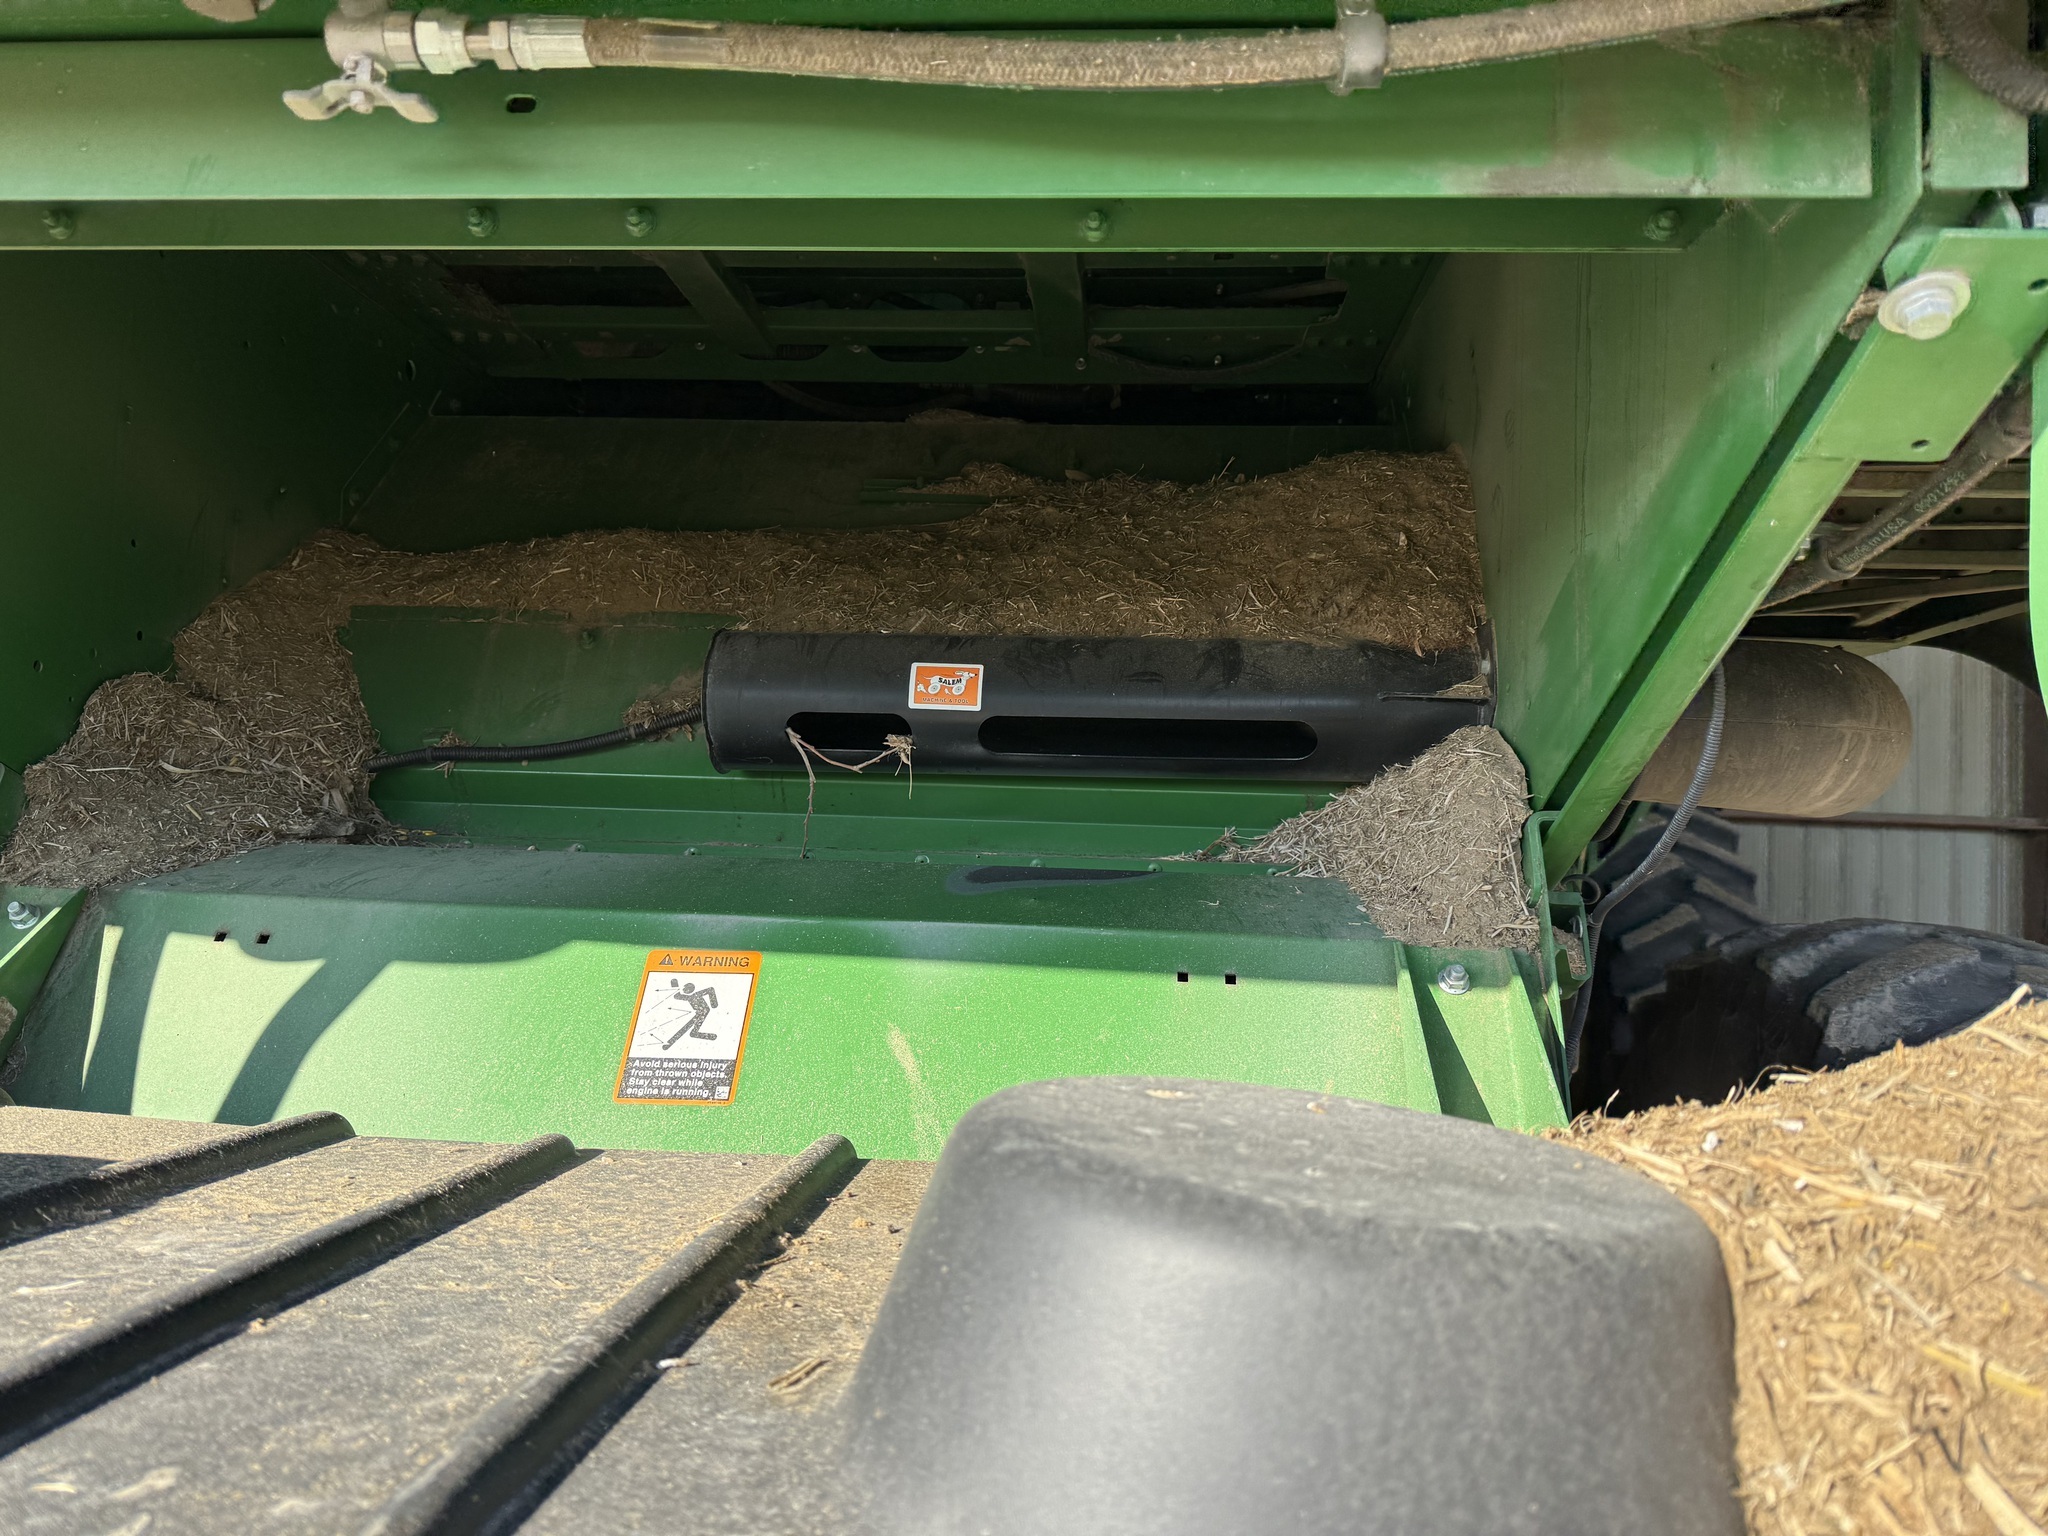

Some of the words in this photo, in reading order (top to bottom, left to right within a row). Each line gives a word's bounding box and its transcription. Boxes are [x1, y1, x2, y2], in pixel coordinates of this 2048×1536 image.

[1879, 517, 1909, 538] USA
[938, 677, 962, 685] SALEM
[680, 955, 750, 968] WARNING
[632, 1060, 660, 1068] Avoid
[663, 1060, 698, 1069] serious
[700, 1061, 727, 1071] injury
[630, 1069, 653, 1077] from
[655, 1069, 688, 1077] thrown
[690, 1070, 727, 1079] objects.
[629, 1077, 651, 1086] Stay
[652, 1078, 676, 1086] clear
[678, 1079, 703, 1087] while
[626, 1087, 659, 1097] engine
[660, 1087, 669, 1095] is
[671, 1088, 712, 1098] running.
